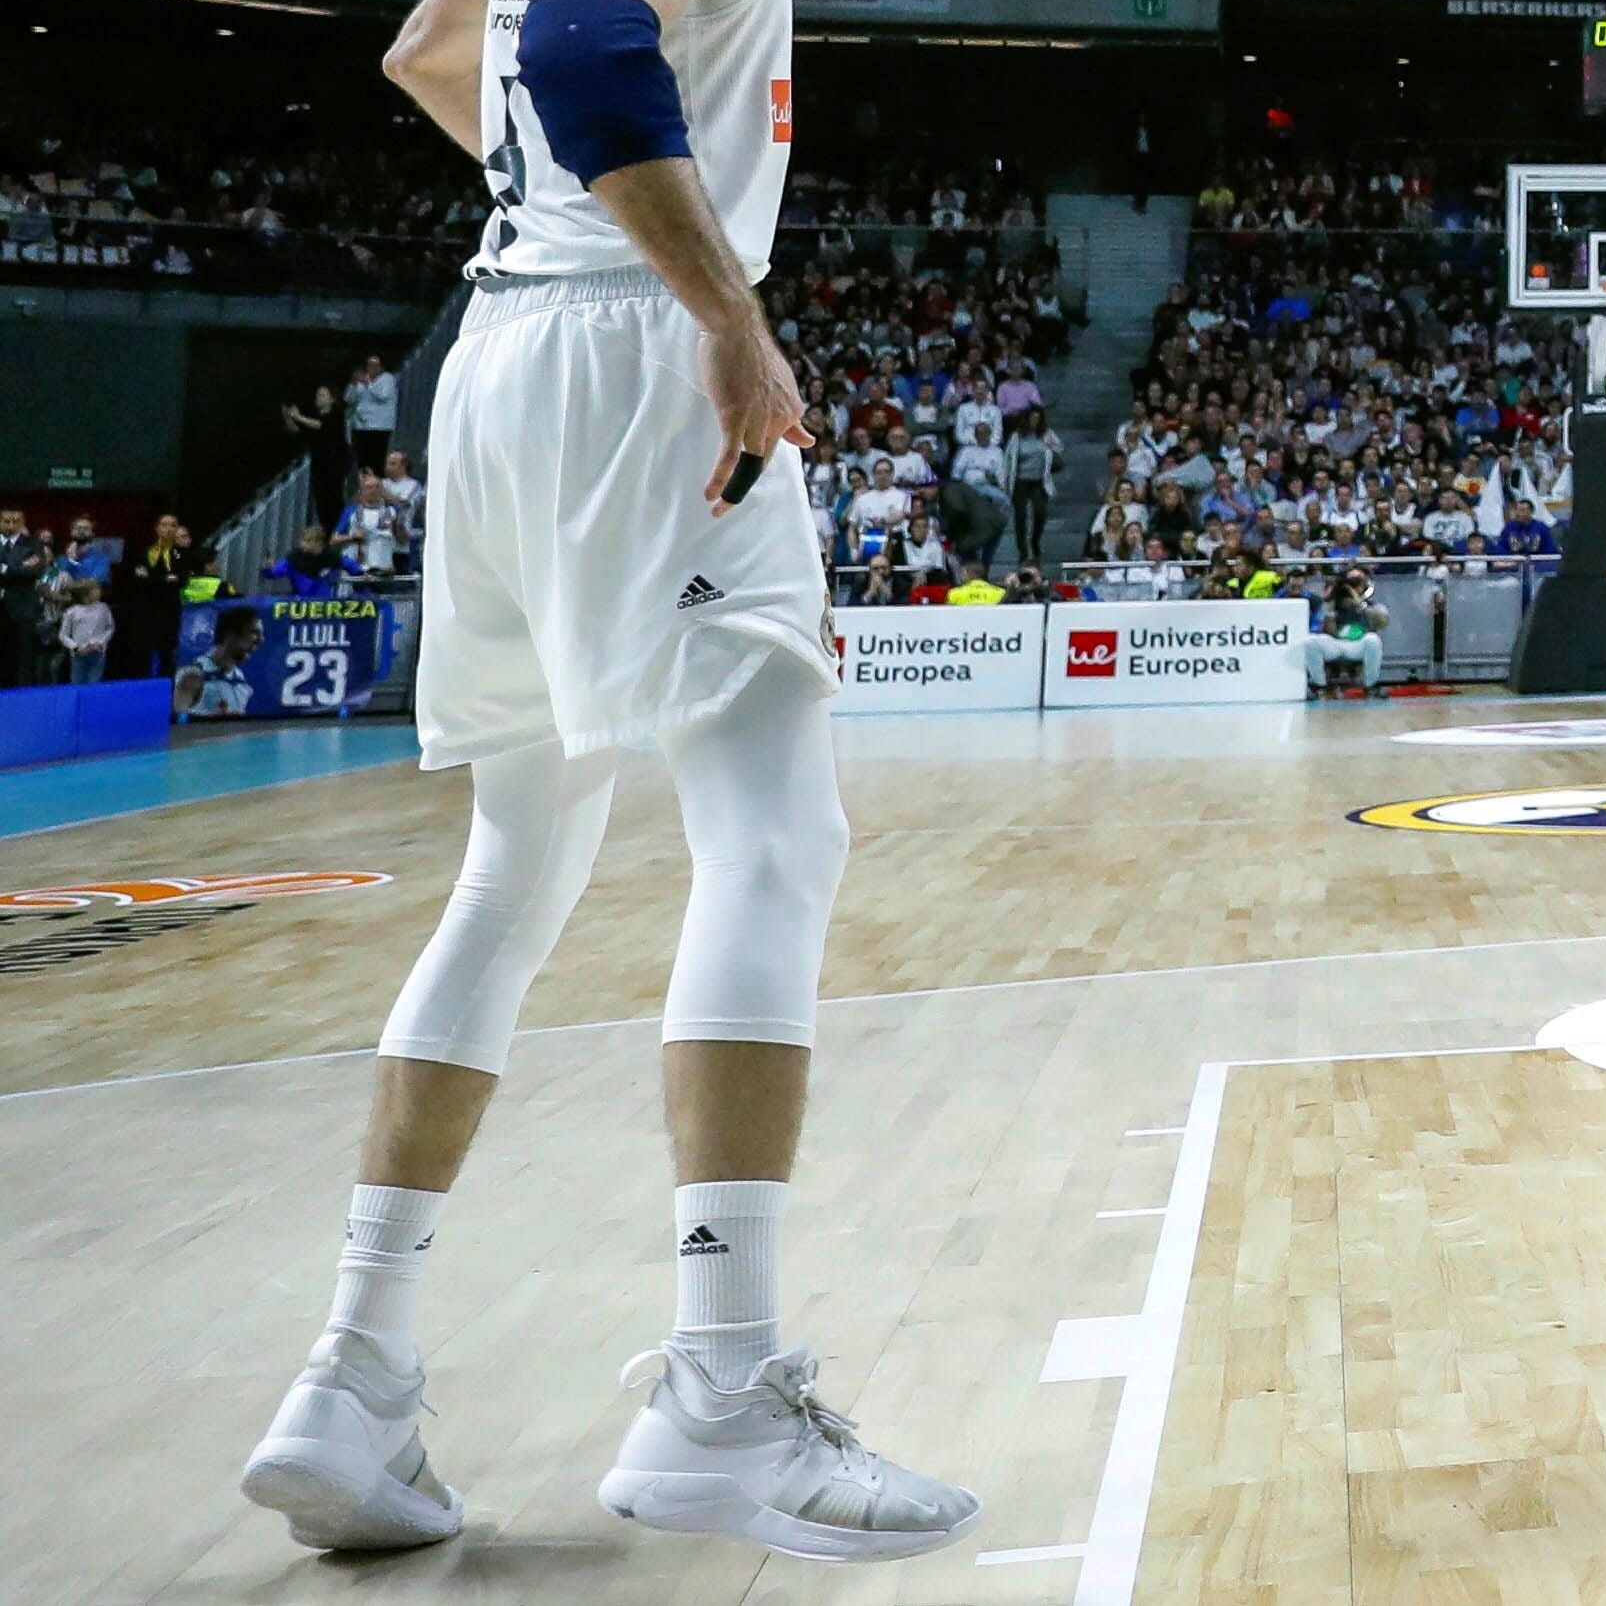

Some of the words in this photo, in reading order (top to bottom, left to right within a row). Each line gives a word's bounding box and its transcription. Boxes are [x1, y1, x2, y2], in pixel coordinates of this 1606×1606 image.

[1448, 0, 1606, 17] BERSERKERS
[273, 600, 378, 620] FUERZA
[677, 590, 725, 610] adidas
[288, 624, 351, 647] LLULL
[857, 631, 1022, 655] Universidad
[1129, 625, 1289, 649] Universidad
[855, 663, 972, 684] Europea
[1128, 654, 1242, 679] Europea
[281, 650, 349, 707] 23
[679, 1244, 730, 1257] adidas
